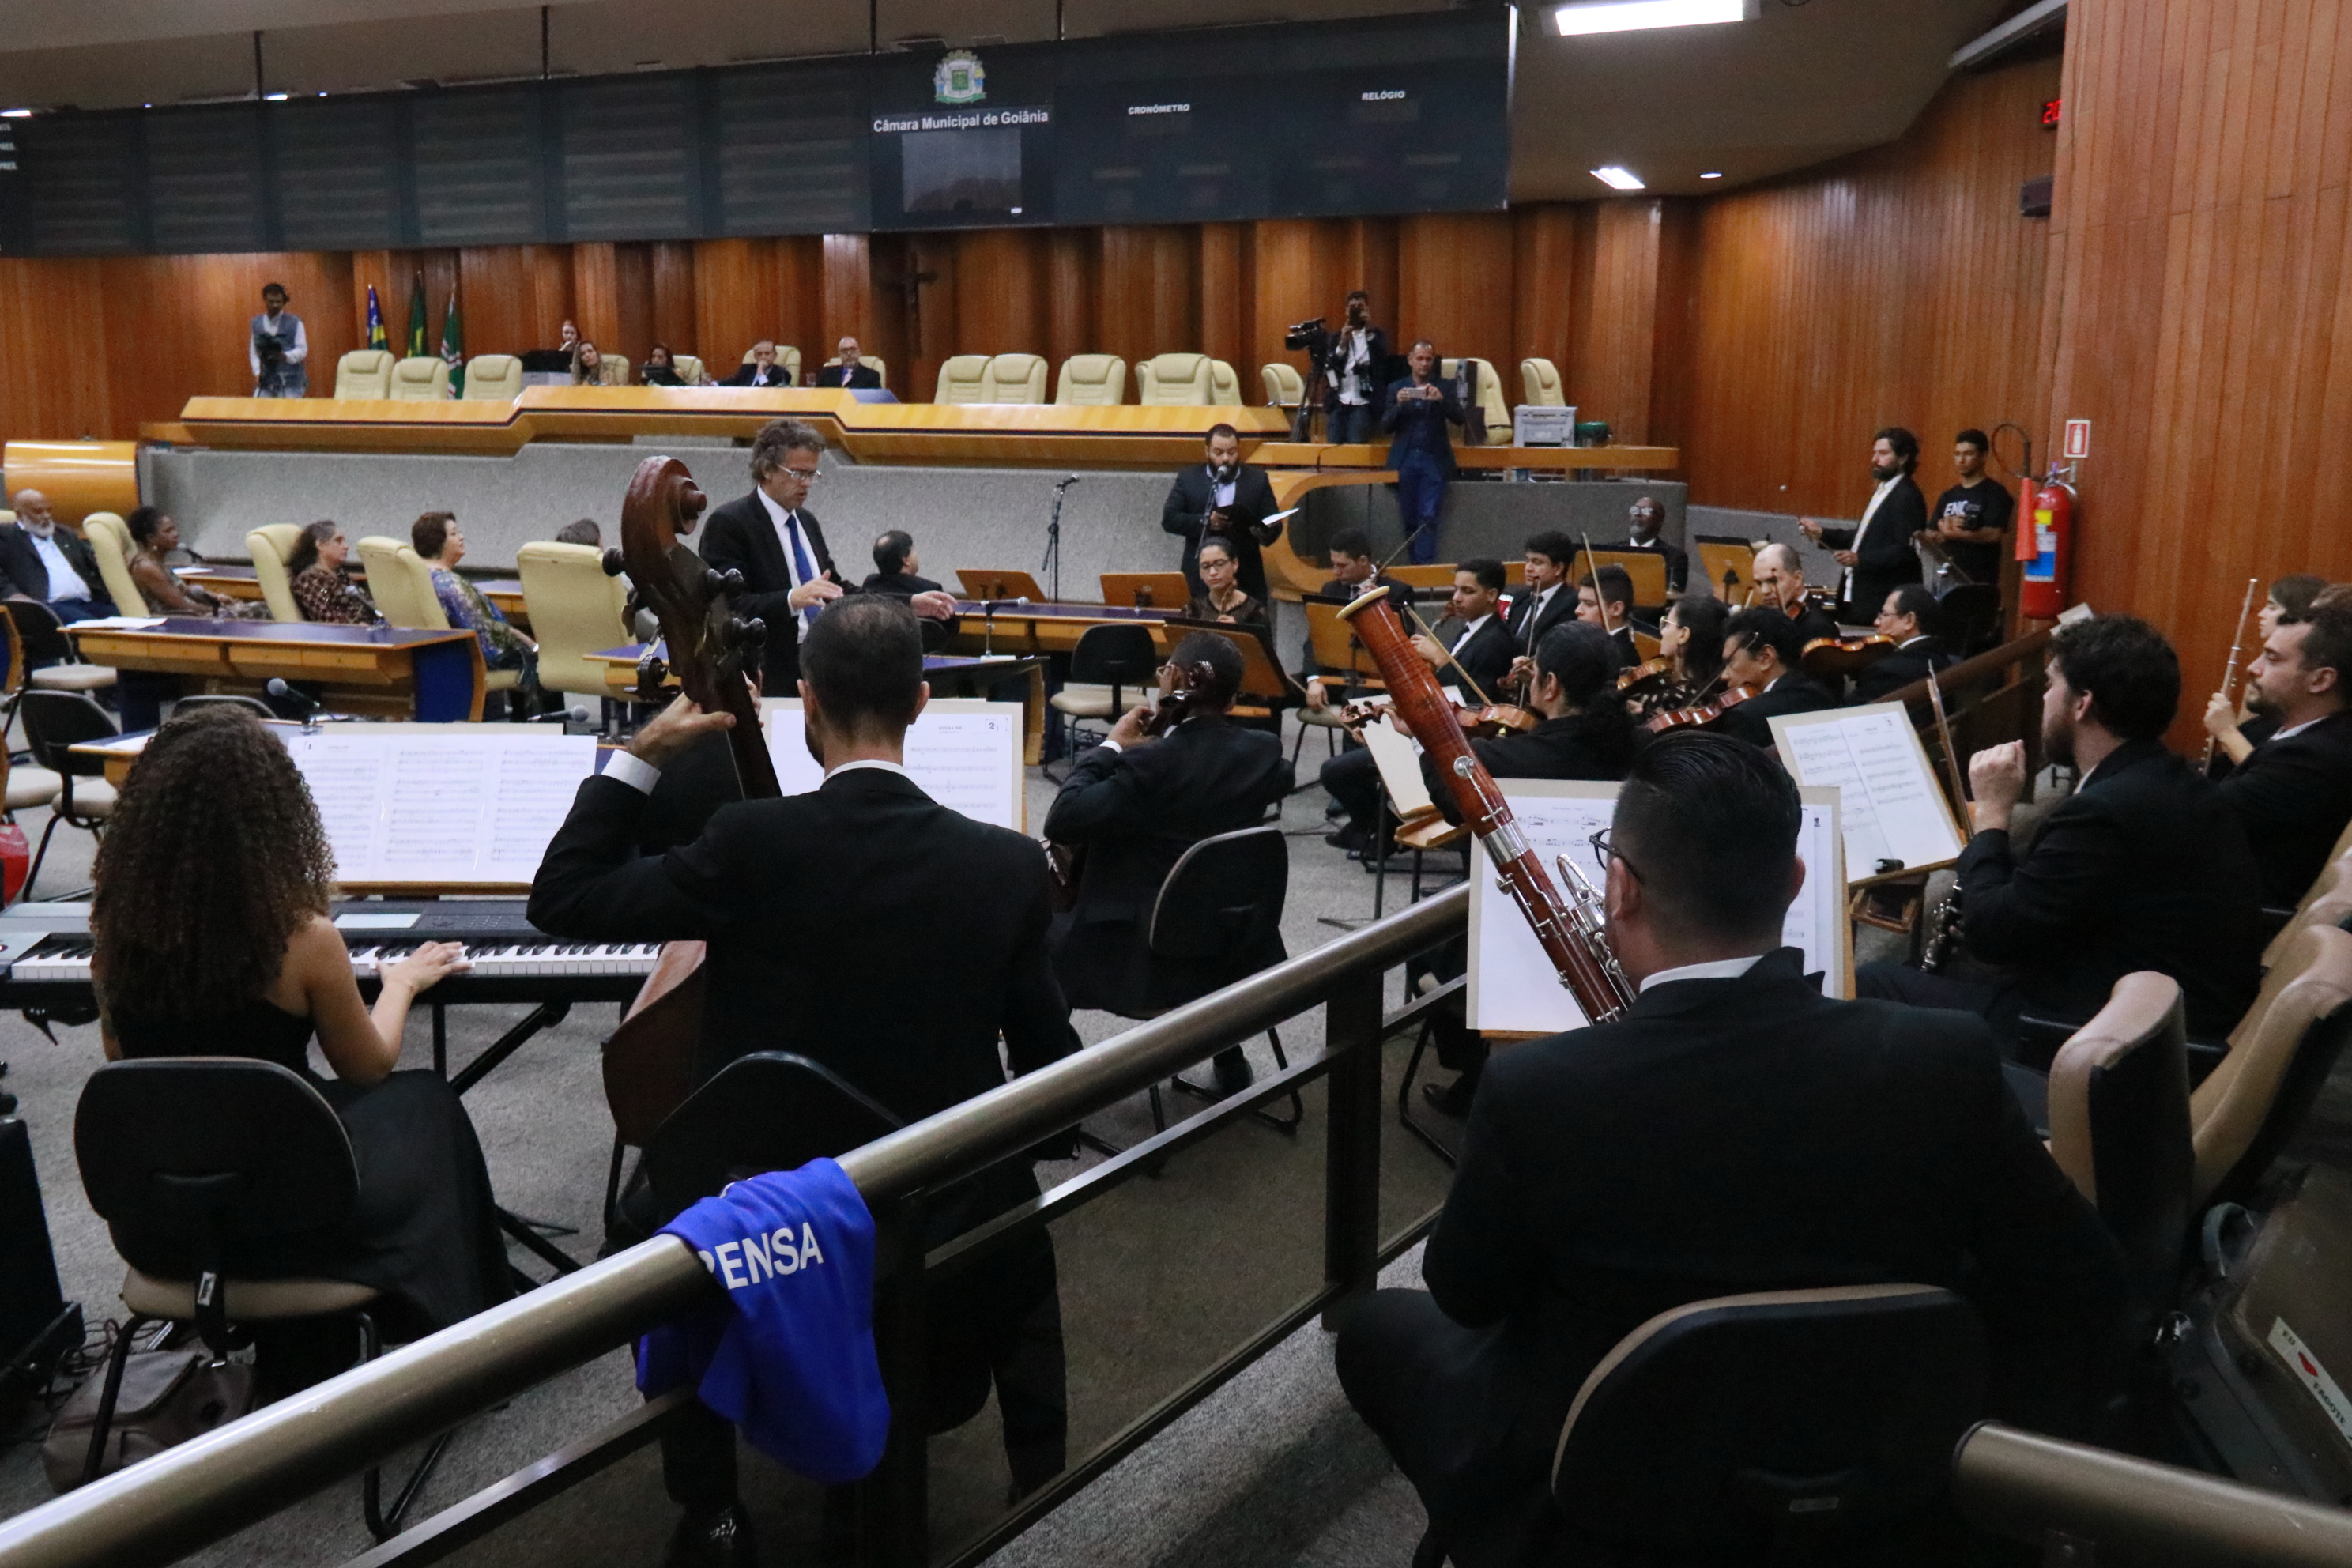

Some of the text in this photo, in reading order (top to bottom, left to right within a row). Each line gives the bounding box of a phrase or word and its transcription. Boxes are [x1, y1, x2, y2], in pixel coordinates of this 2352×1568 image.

[1362, 90, 1405, 100] RELÓGIO
[873, 110, 1049, 132] Câmara Municipal de Goiânia
[988, 722, 995, 730] 2
